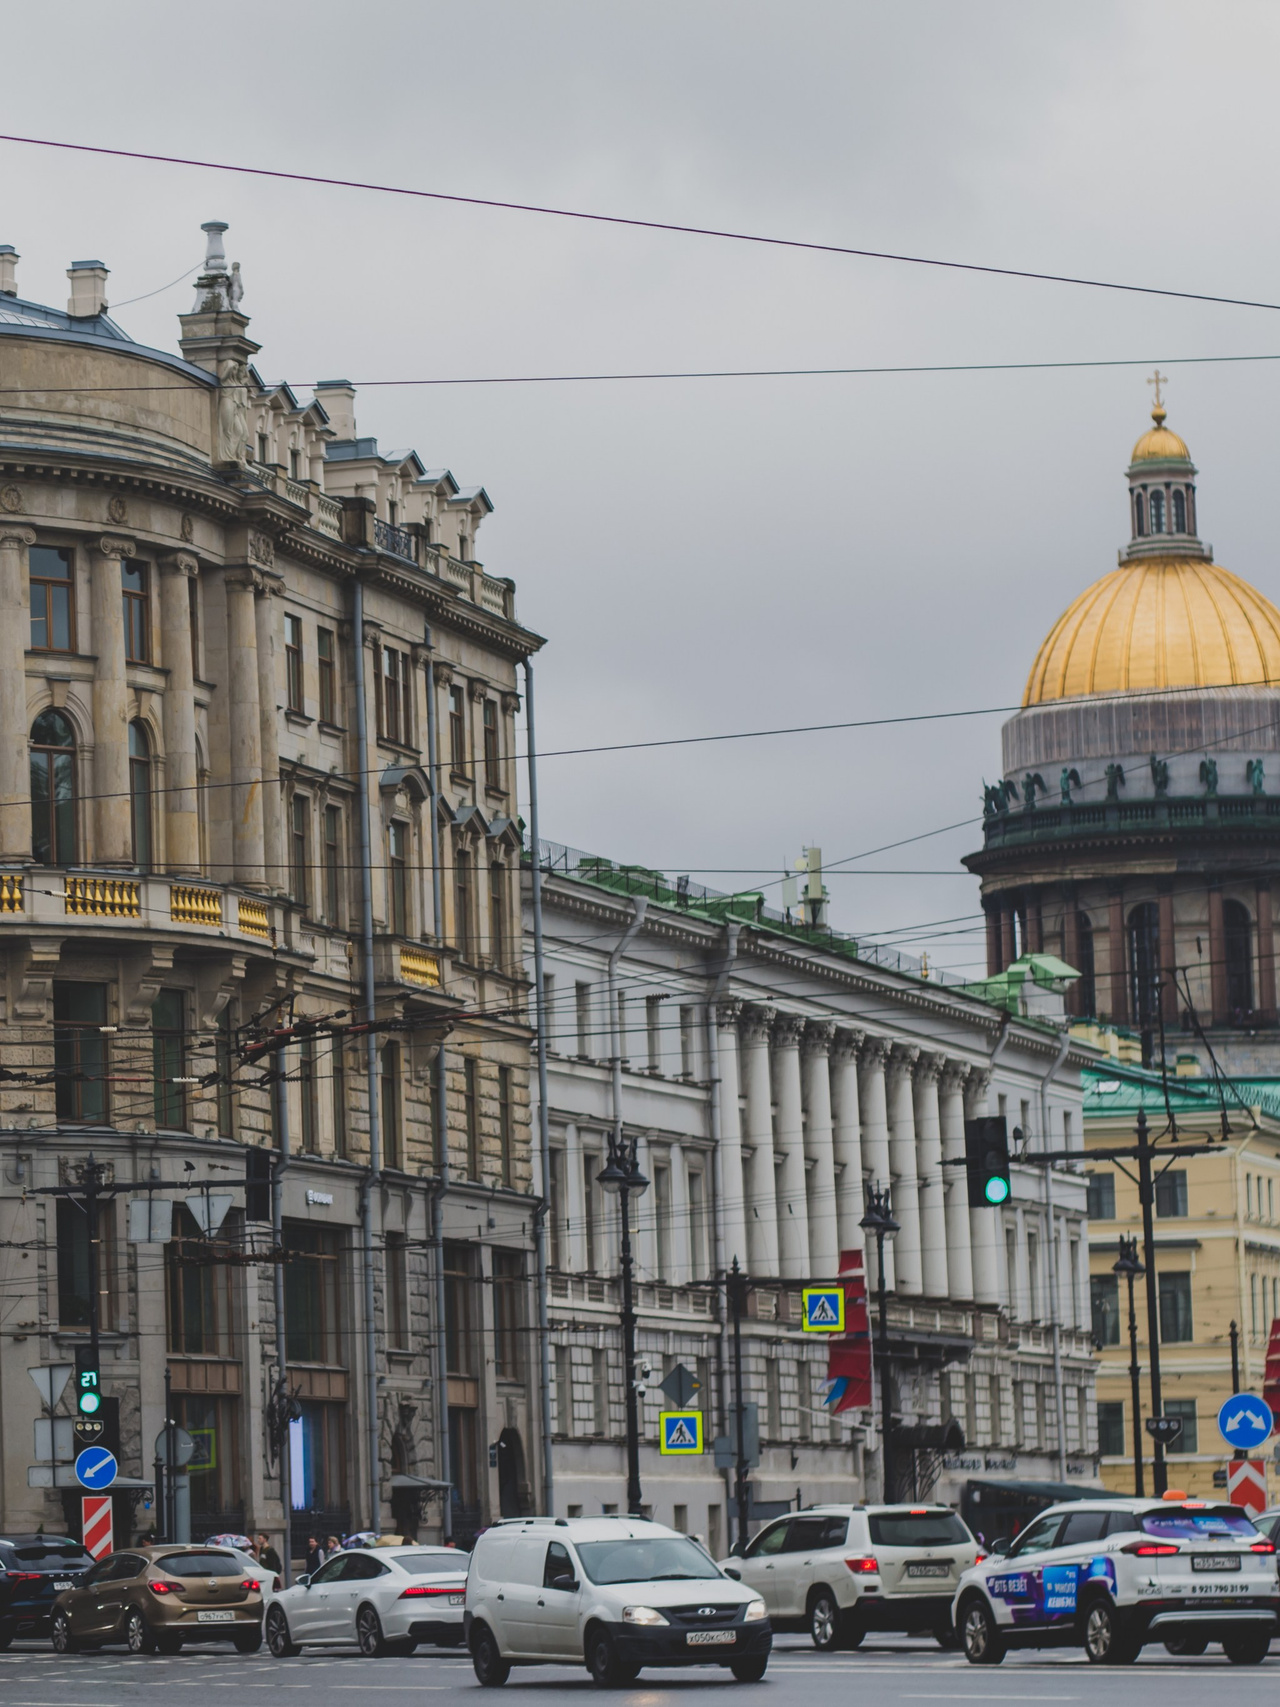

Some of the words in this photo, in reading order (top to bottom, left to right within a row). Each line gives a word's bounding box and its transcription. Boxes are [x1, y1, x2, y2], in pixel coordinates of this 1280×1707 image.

[80, 1371, 98, 1387] 27
[994, 1579, 1007, 1593] ВТБ
[1199, 1585, 1212, 1593] 921
[1214, 1585, 1228, 1593] 790
[1239, 1584, 1249, 1592] 99
